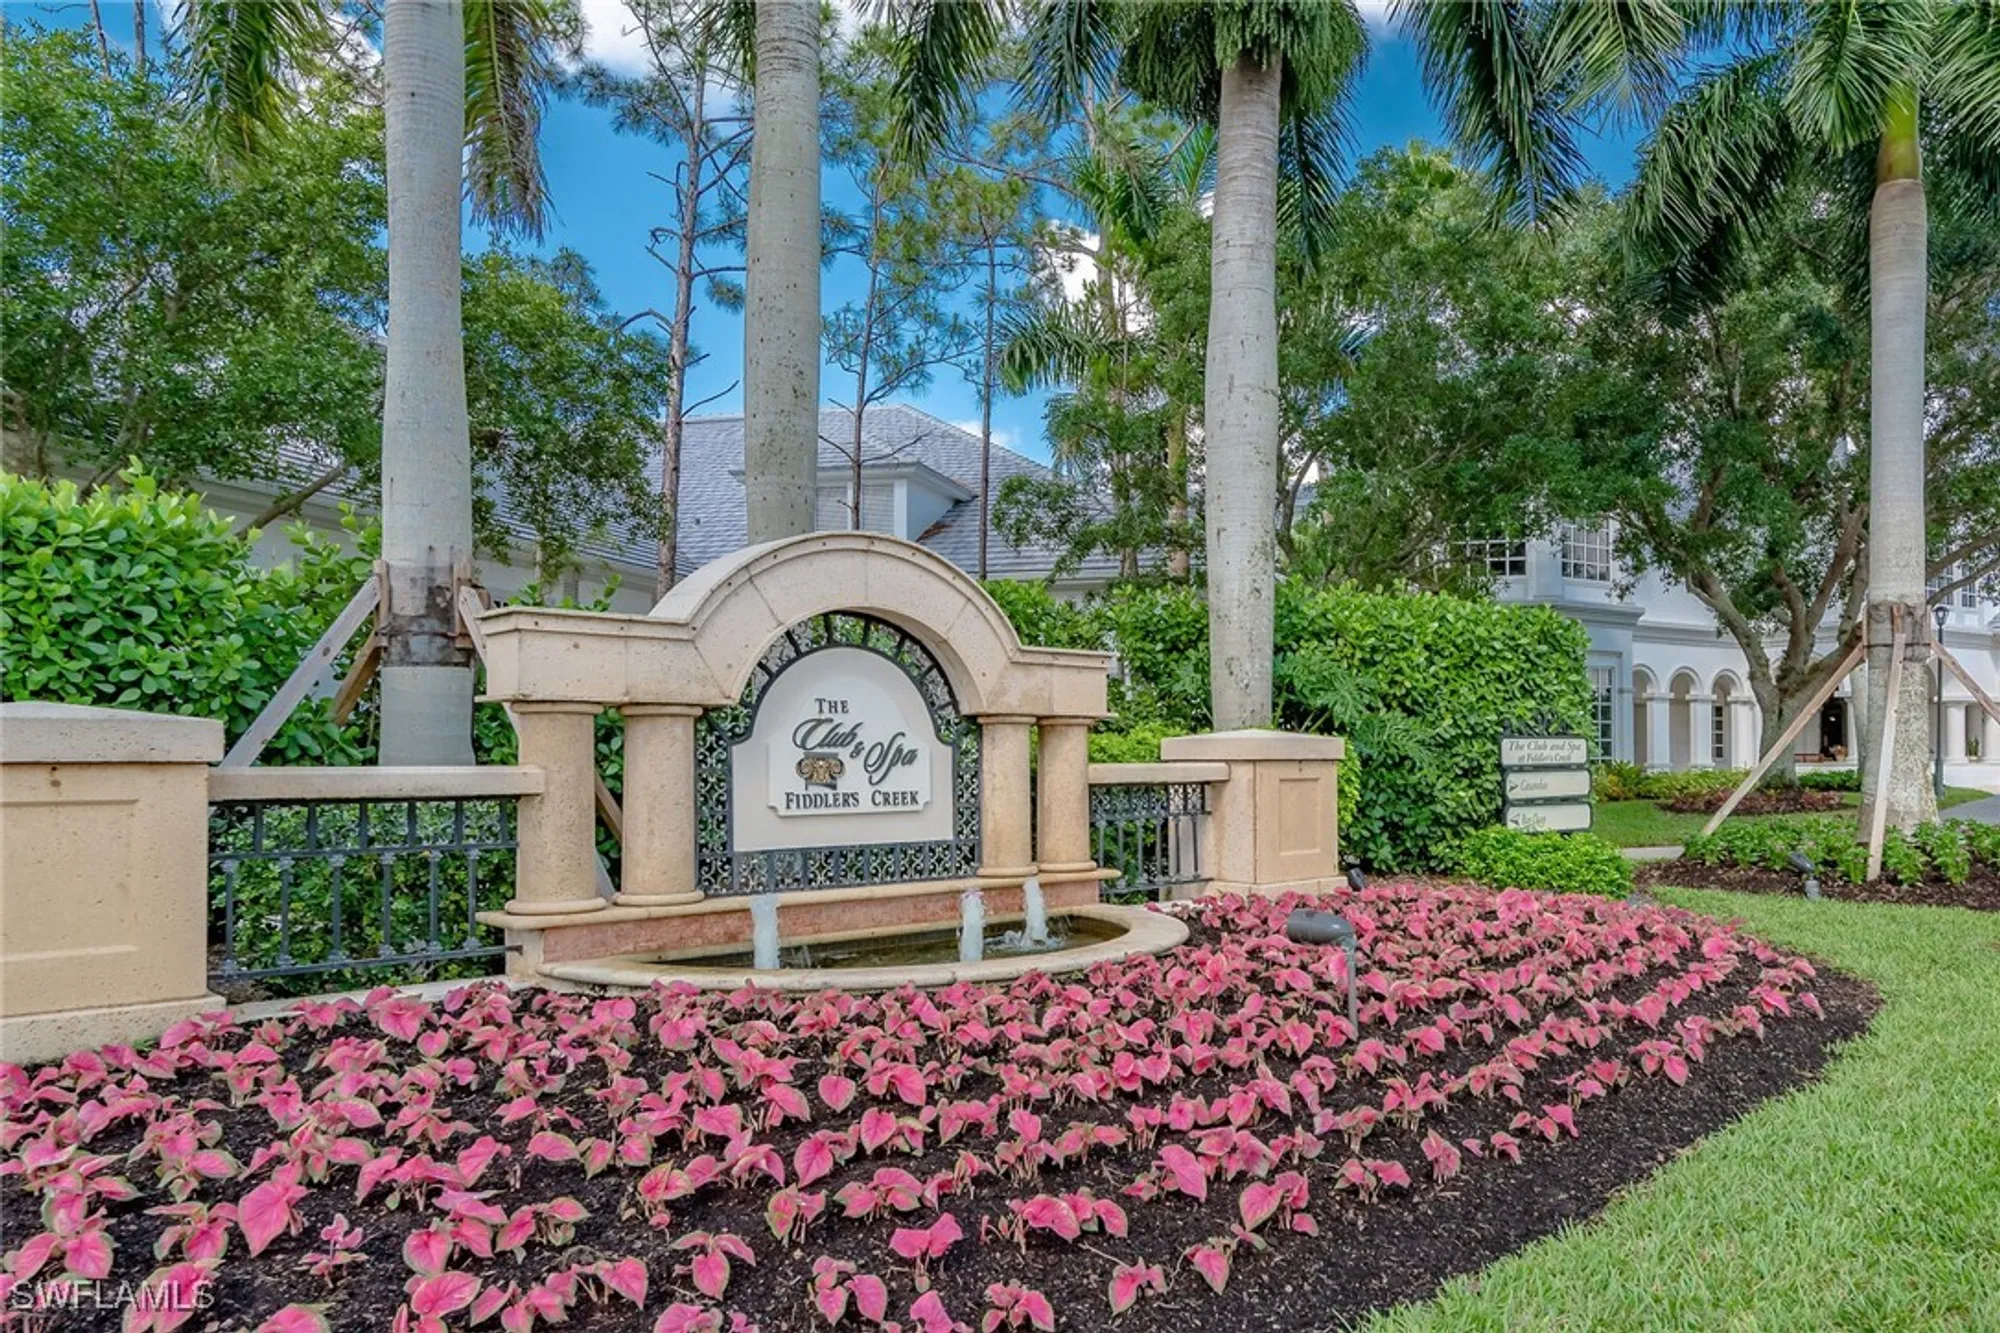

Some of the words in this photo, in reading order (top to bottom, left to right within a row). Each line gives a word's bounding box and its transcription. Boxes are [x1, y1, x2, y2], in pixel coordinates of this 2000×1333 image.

[815, 698, 849, 714] THE
[792, 718, 863, 751] Club
[849, 741, 865, 758] &
[863, 732, 918, 786] Spa
[1509, 741, 1525, 751] The
[1527, 740, 1548, 751] Club
[1550, 740, 1566, 751] and
[1568, 741, 1582, 753] Spa
[871, 789, 919, 807] CREEK
